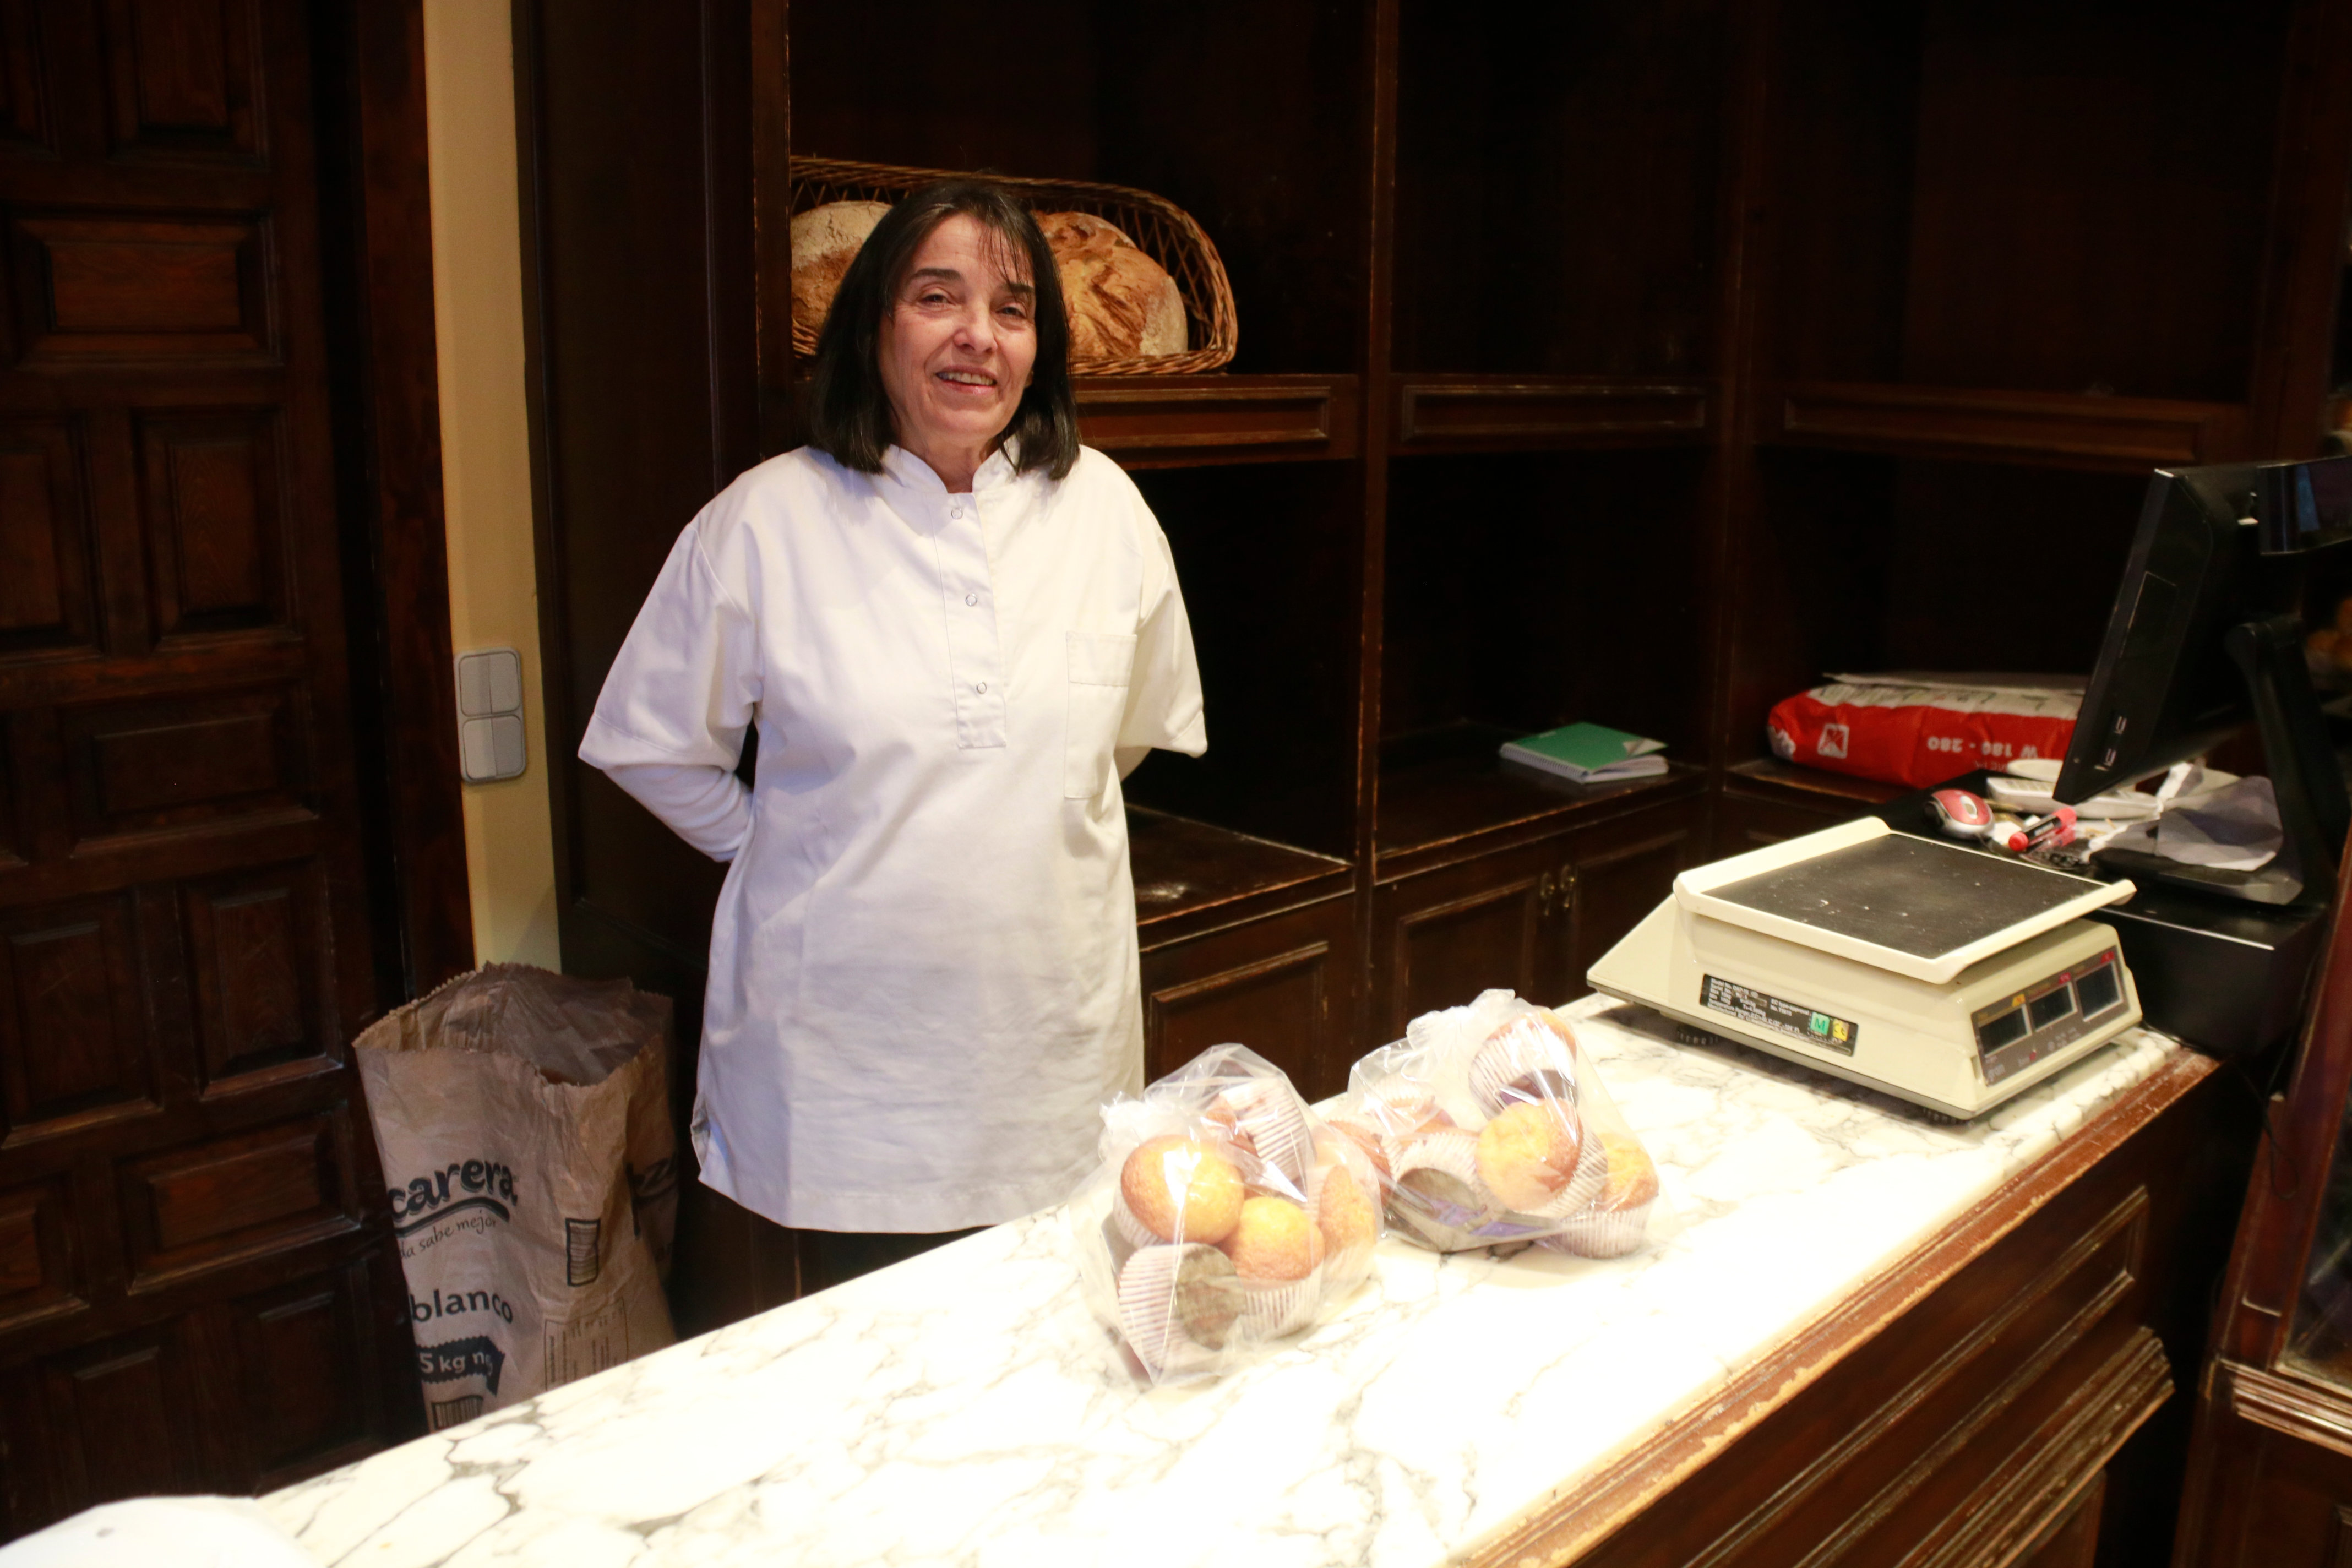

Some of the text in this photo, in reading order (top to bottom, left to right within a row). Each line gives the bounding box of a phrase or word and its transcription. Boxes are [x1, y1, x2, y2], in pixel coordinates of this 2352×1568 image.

[1928, 736, 1963, 753] 280
[1815, 1018, 1826, 1032] M
[418, 1226, 450, 1252] sabe
[456, 1209, 497, 1235] mejor
[409, 1288, 513, 1324] blanco
[418, 1352, 434, 1374] 5
[440, 1355, 466, 1374] kg
